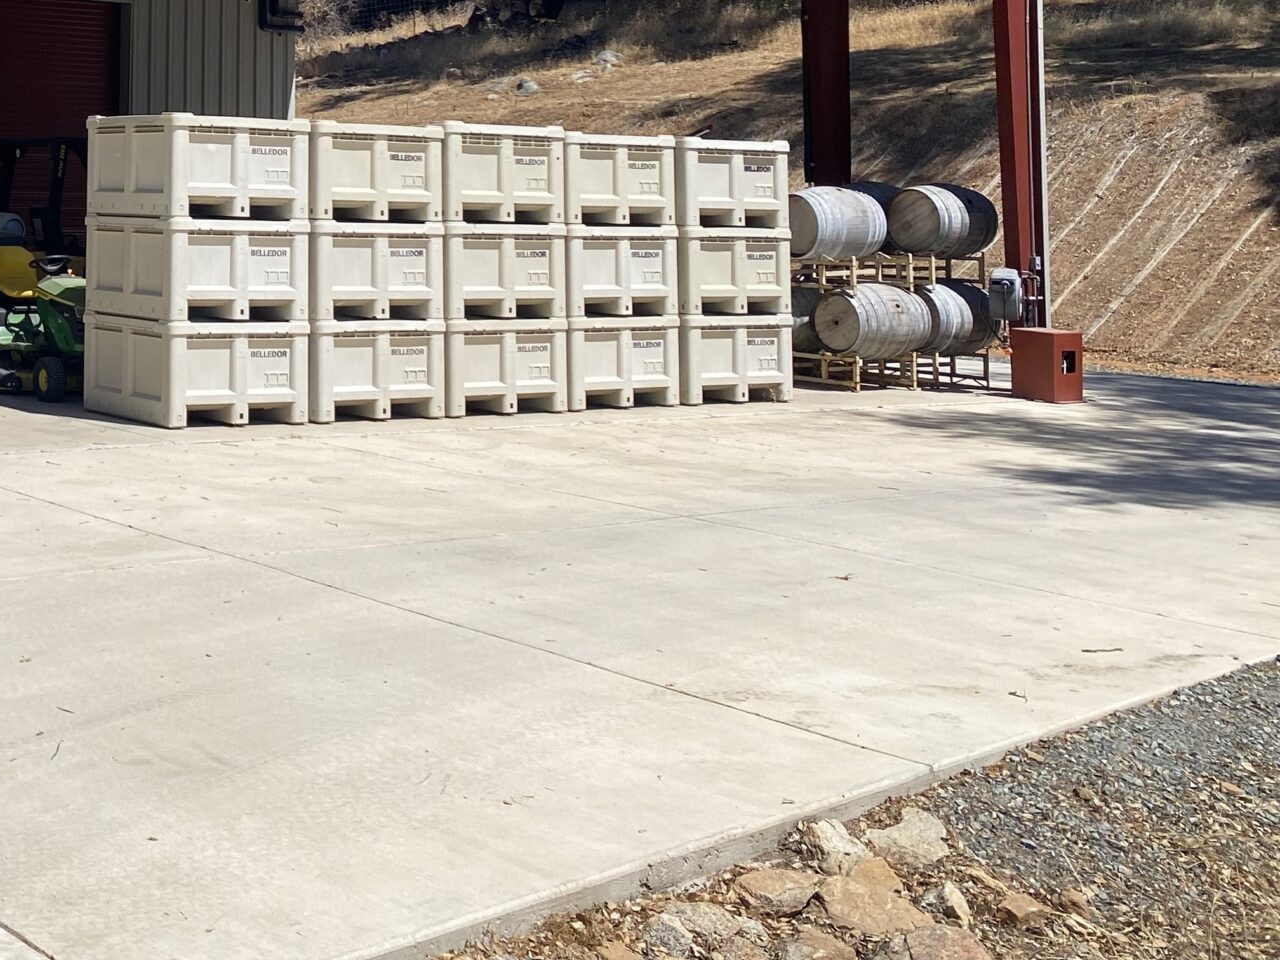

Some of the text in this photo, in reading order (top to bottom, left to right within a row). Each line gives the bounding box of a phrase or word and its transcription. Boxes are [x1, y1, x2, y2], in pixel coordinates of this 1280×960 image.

[251, 148, 288, 156] BELLEDOR
[389, 154, 423, 162] BELLEDOR
[515, 158, 546, 166] BELLEDOR
[251, 249, 287, 257] BELLEDOR
[390, 249, 424, 257] BELLEDOR
[391, 348, 424, 356] BELLEDOR
[517, 345, 548, 353] BELLEDOR
[250, 350, 287, 358] BELLEDOR
